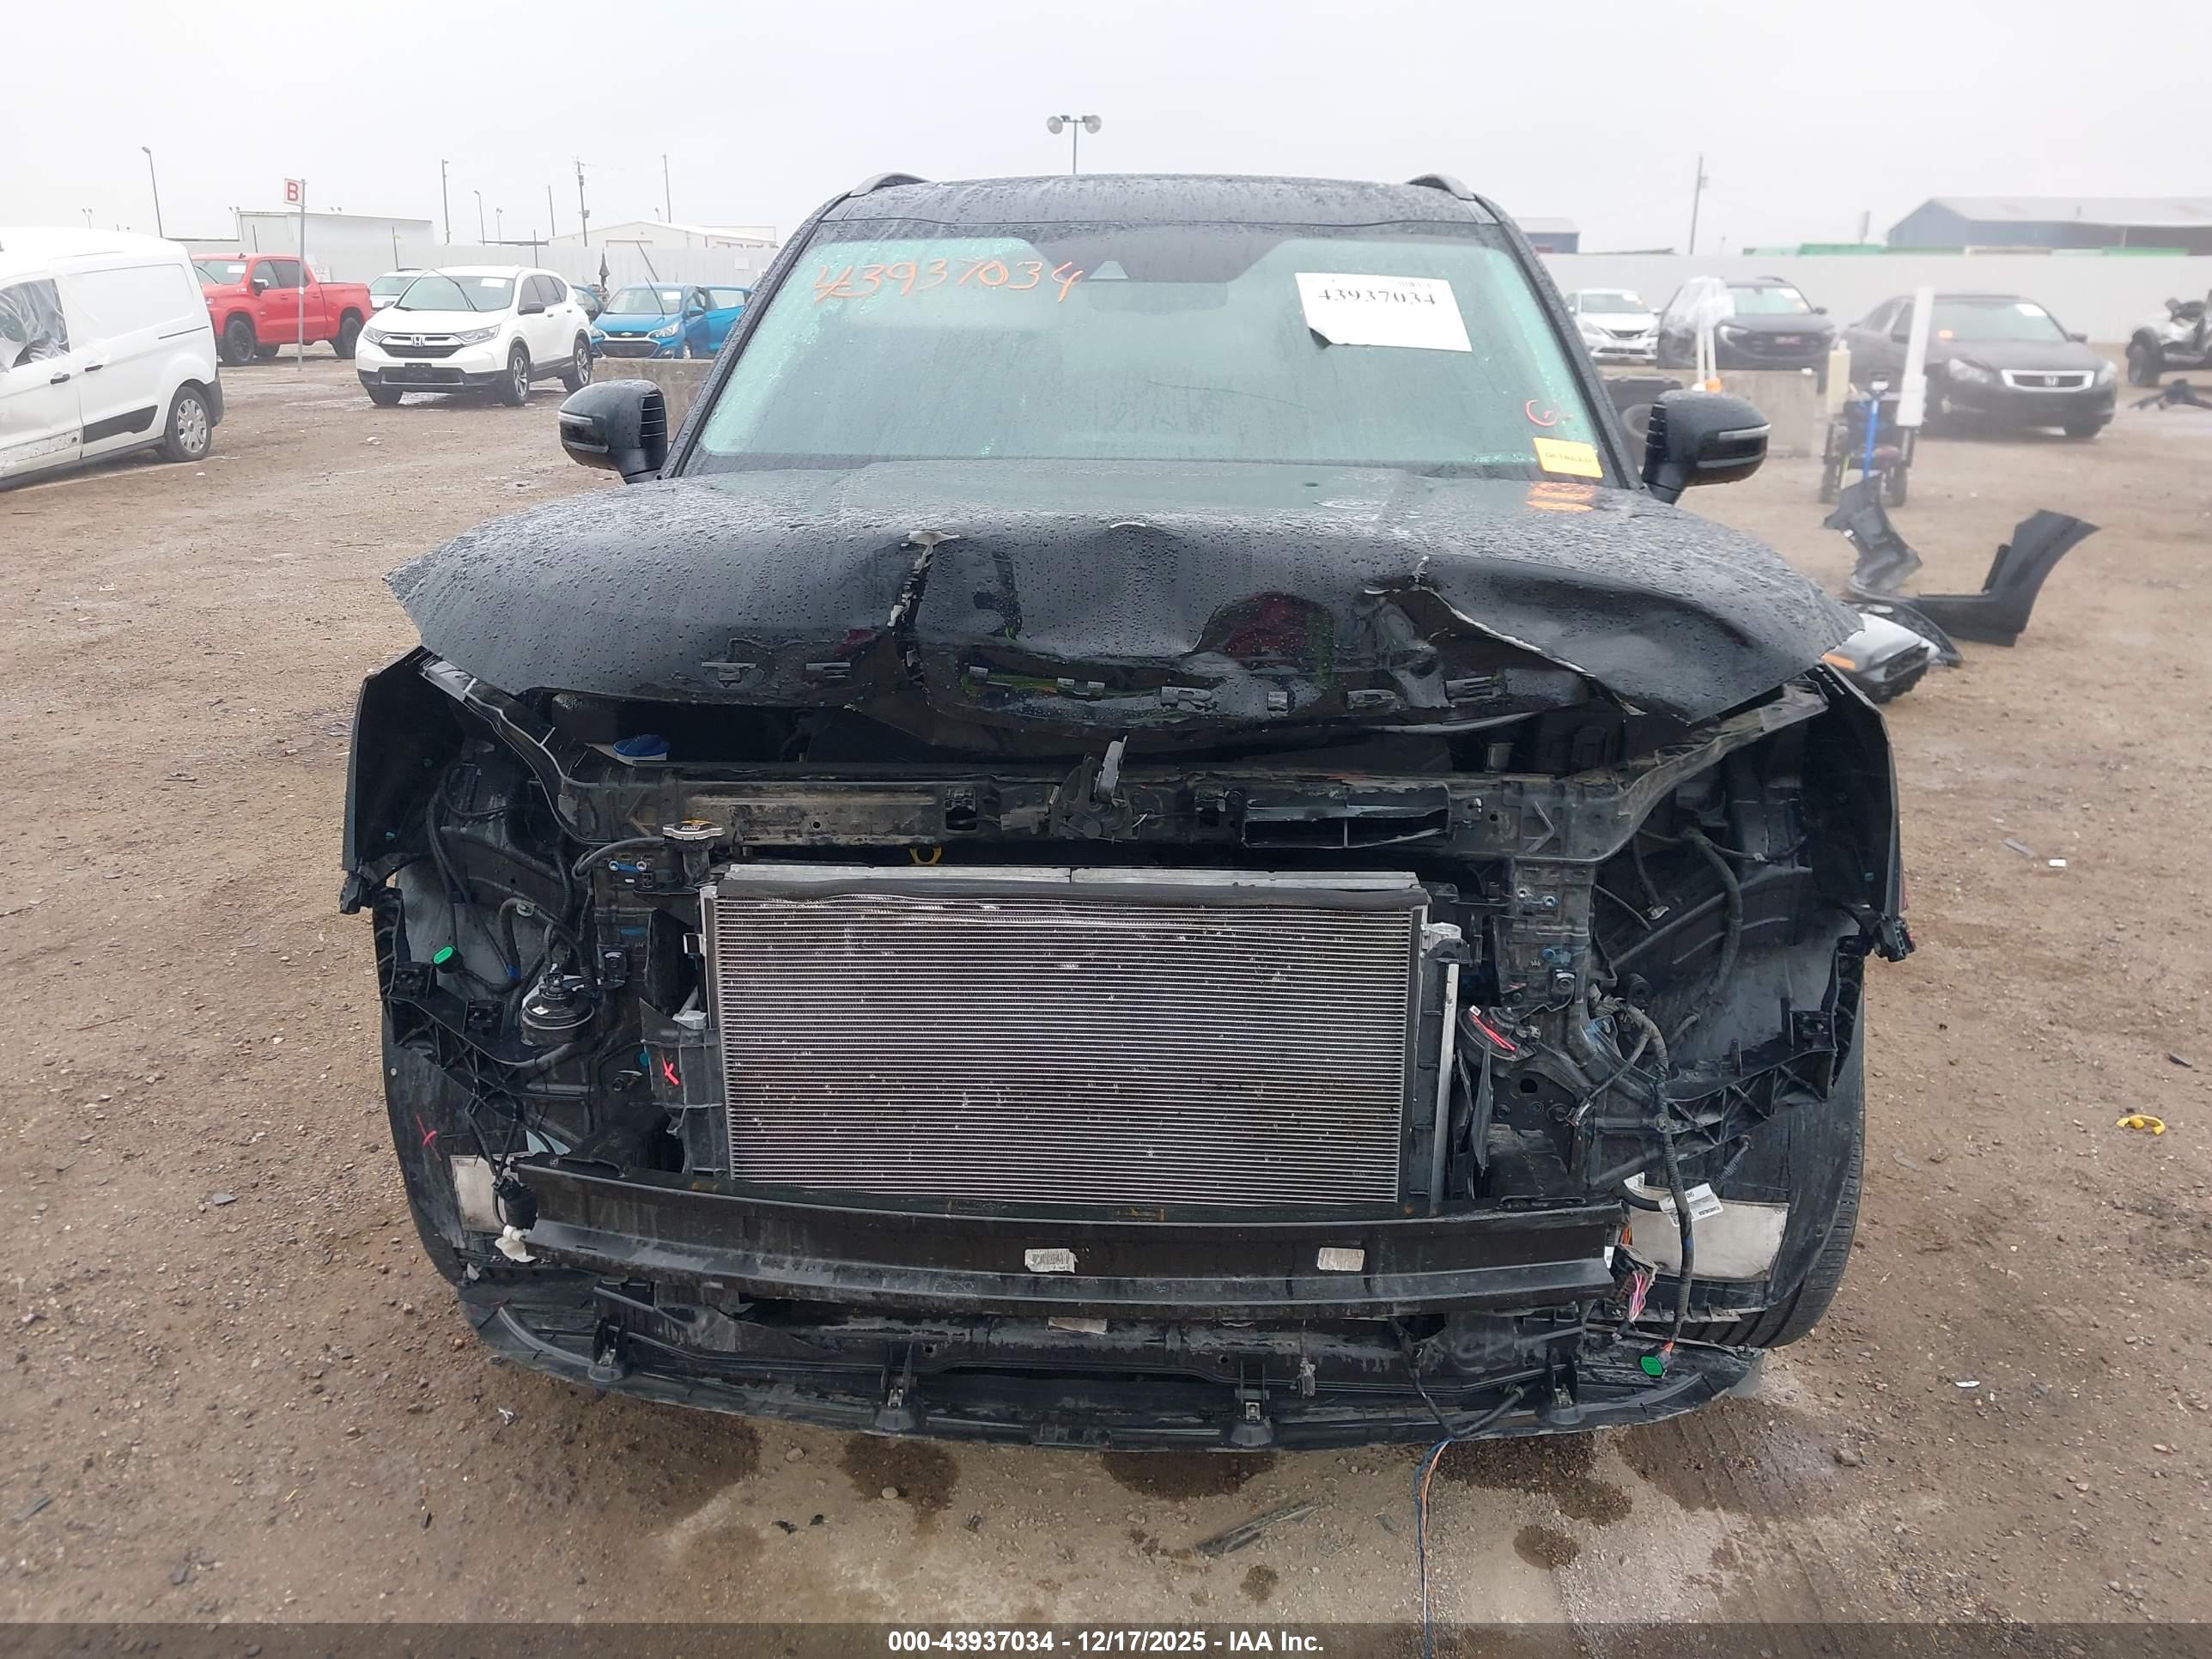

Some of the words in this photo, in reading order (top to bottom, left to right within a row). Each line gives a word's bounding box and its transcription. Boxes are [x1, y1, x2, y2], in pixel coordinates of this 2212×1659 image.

[288, 181, 299, 202] B
[814, 258, 1085, 303] 43937034
[1318, 289, 1436, 305] 43937034
